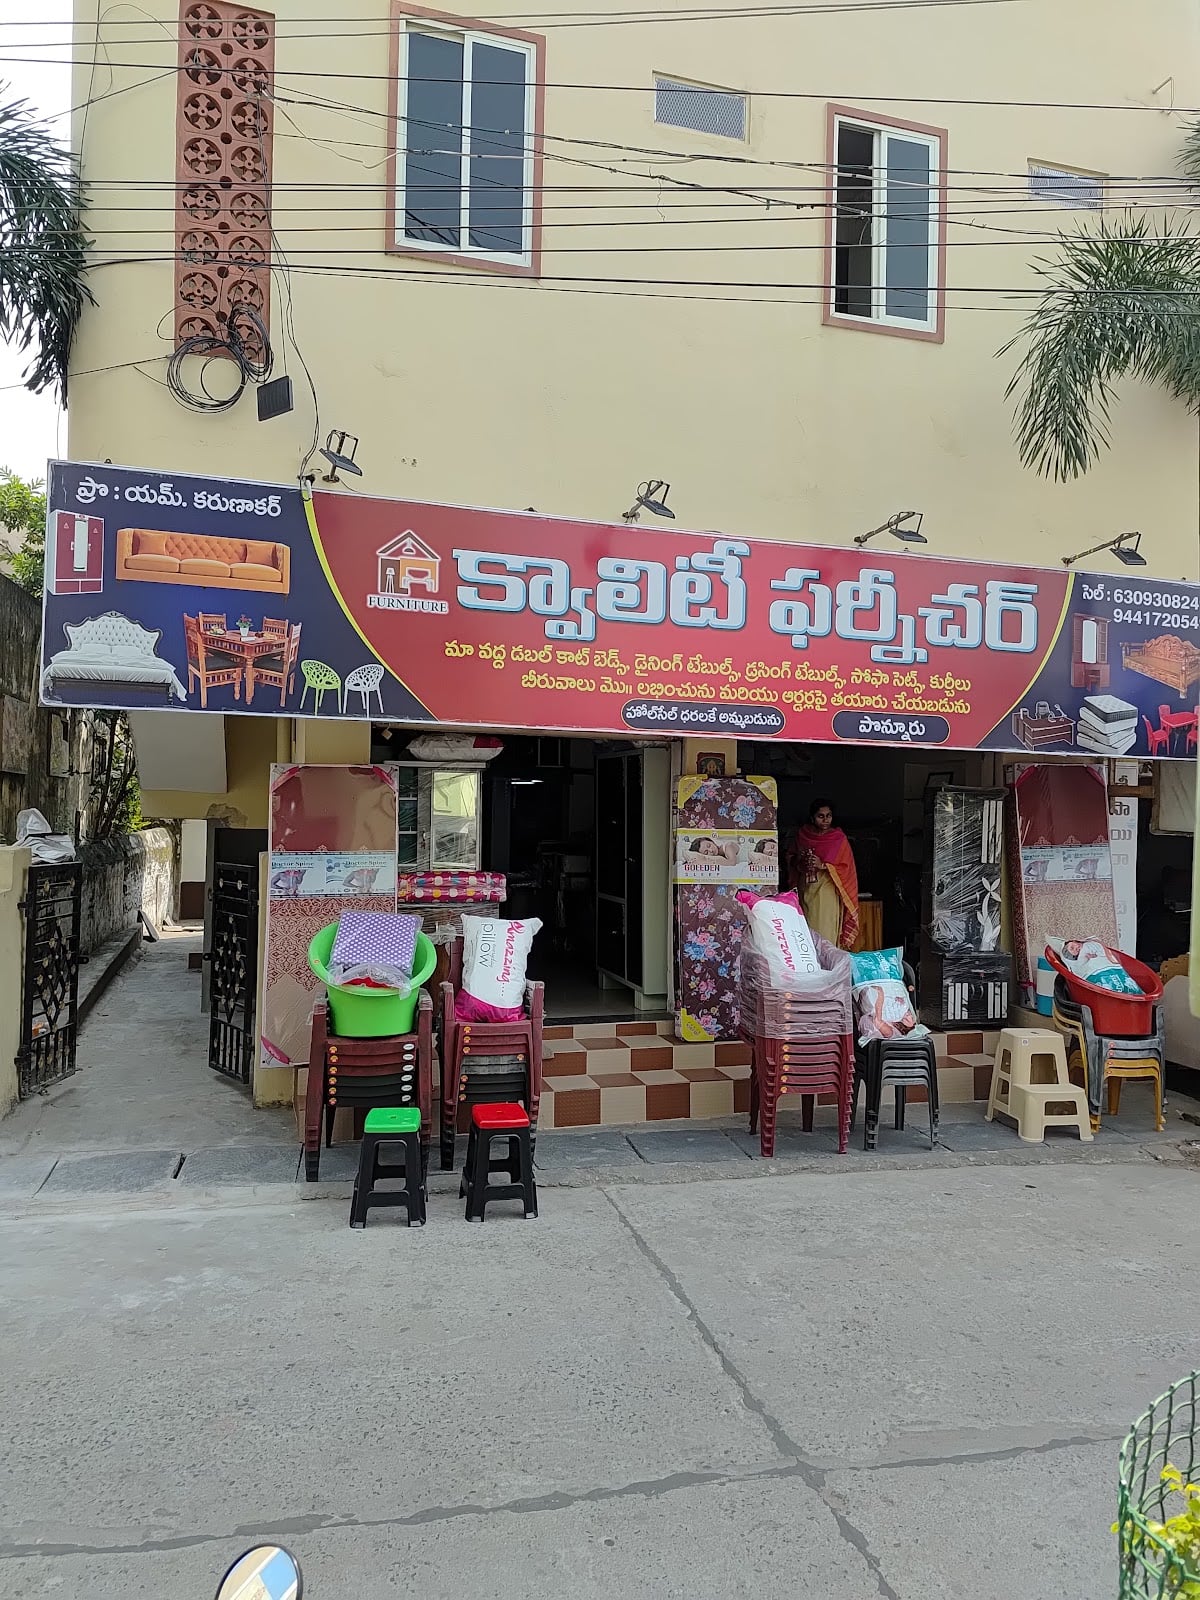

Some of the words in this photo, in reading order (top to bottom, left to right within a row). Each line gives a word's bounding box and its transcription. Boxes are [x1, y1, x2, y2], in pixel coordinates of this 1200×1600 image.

[124, 482, 188, 507] యమ్.
[193, 490, 282, 517] కరుణాకర్
[369, 596, 448, 613] FURNITURE
[452, 540, 751, 642] క్వాలిటీ
[769, 568, 1039, 664] ఫర్నీచర్
[1113, 608, 1200, 630] 944172054
[445, 640, 475, 657] మా
[478, 643, 506, 669] వద్ద
[511, 644, 553, 664] డబల్
[556, 647, 591, 667] కాట్
[634, 653, 684, 677] డైనింగ్
[850, 668, 890, 688] సోఫా
[929, 672, 971, 697] కుర్చీలు
[521, 669, 596, 692] బీరువాలు
[637, 682, 716, 700] లభించును
[719, 685, 779, 702] మరియు
[781, 689, 828, 712] ఆర్డర్లపై
[830, 692, 888, 711] తయారు
[891, 692, 971, 714] చేయబడును
[718, 711, 782, 729] అమ్మబడును
[858, 715, 926, 742] పొన్నూరు
[478, 923, 497, 968] pillow
